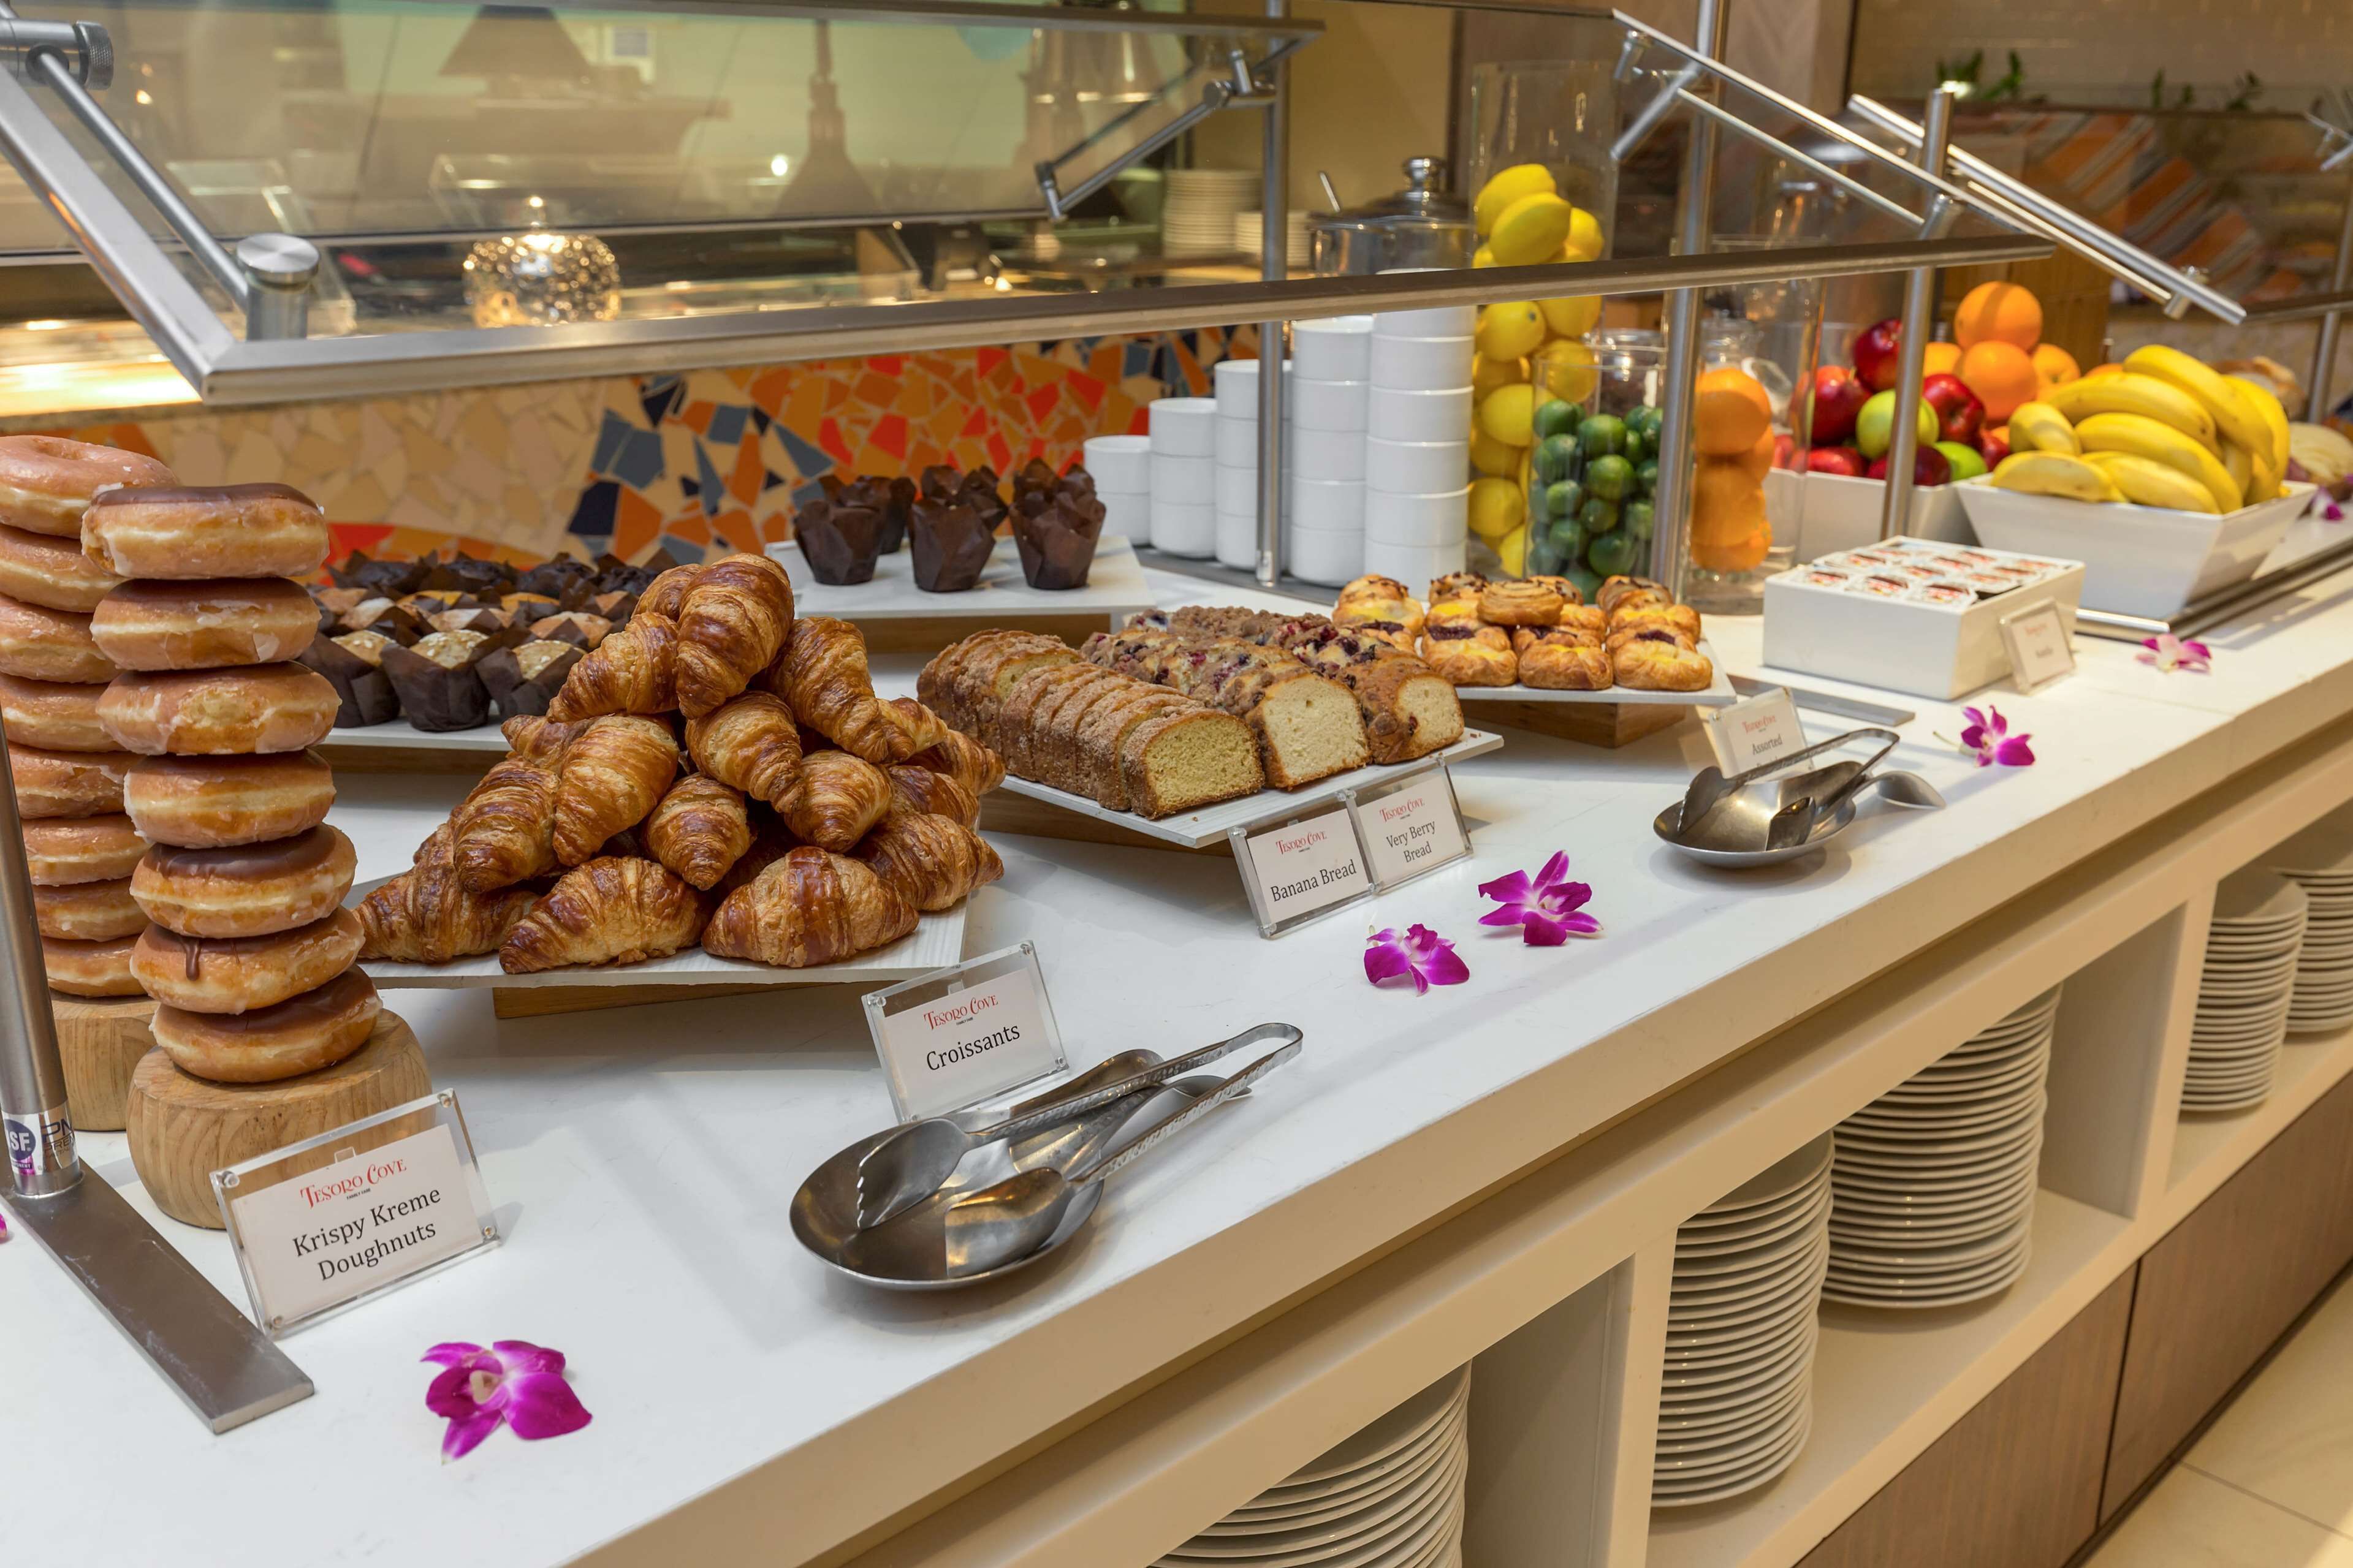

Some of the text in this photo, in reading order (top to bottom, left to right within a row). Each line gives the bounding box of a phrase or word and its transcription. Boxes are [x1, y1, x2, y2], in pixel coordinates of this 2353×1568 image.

[1752, 733, 1782, 755] Assorted
[1386, 821, 1435, 848] Very Berry
[1404, 841, 1432, 863] Bread
[1270, 859, 1356, 902] Banana Bread
[924, 994, 998, 1031] TESORO COVE
[926, 1025, 1021, 1071] Croissants
[300, 1159, 407, 1209] TESORO COVE
[292, 1189, 441, 1257] Krispy Kreme
[317, 1222, 436, 1281] Doughnuts
